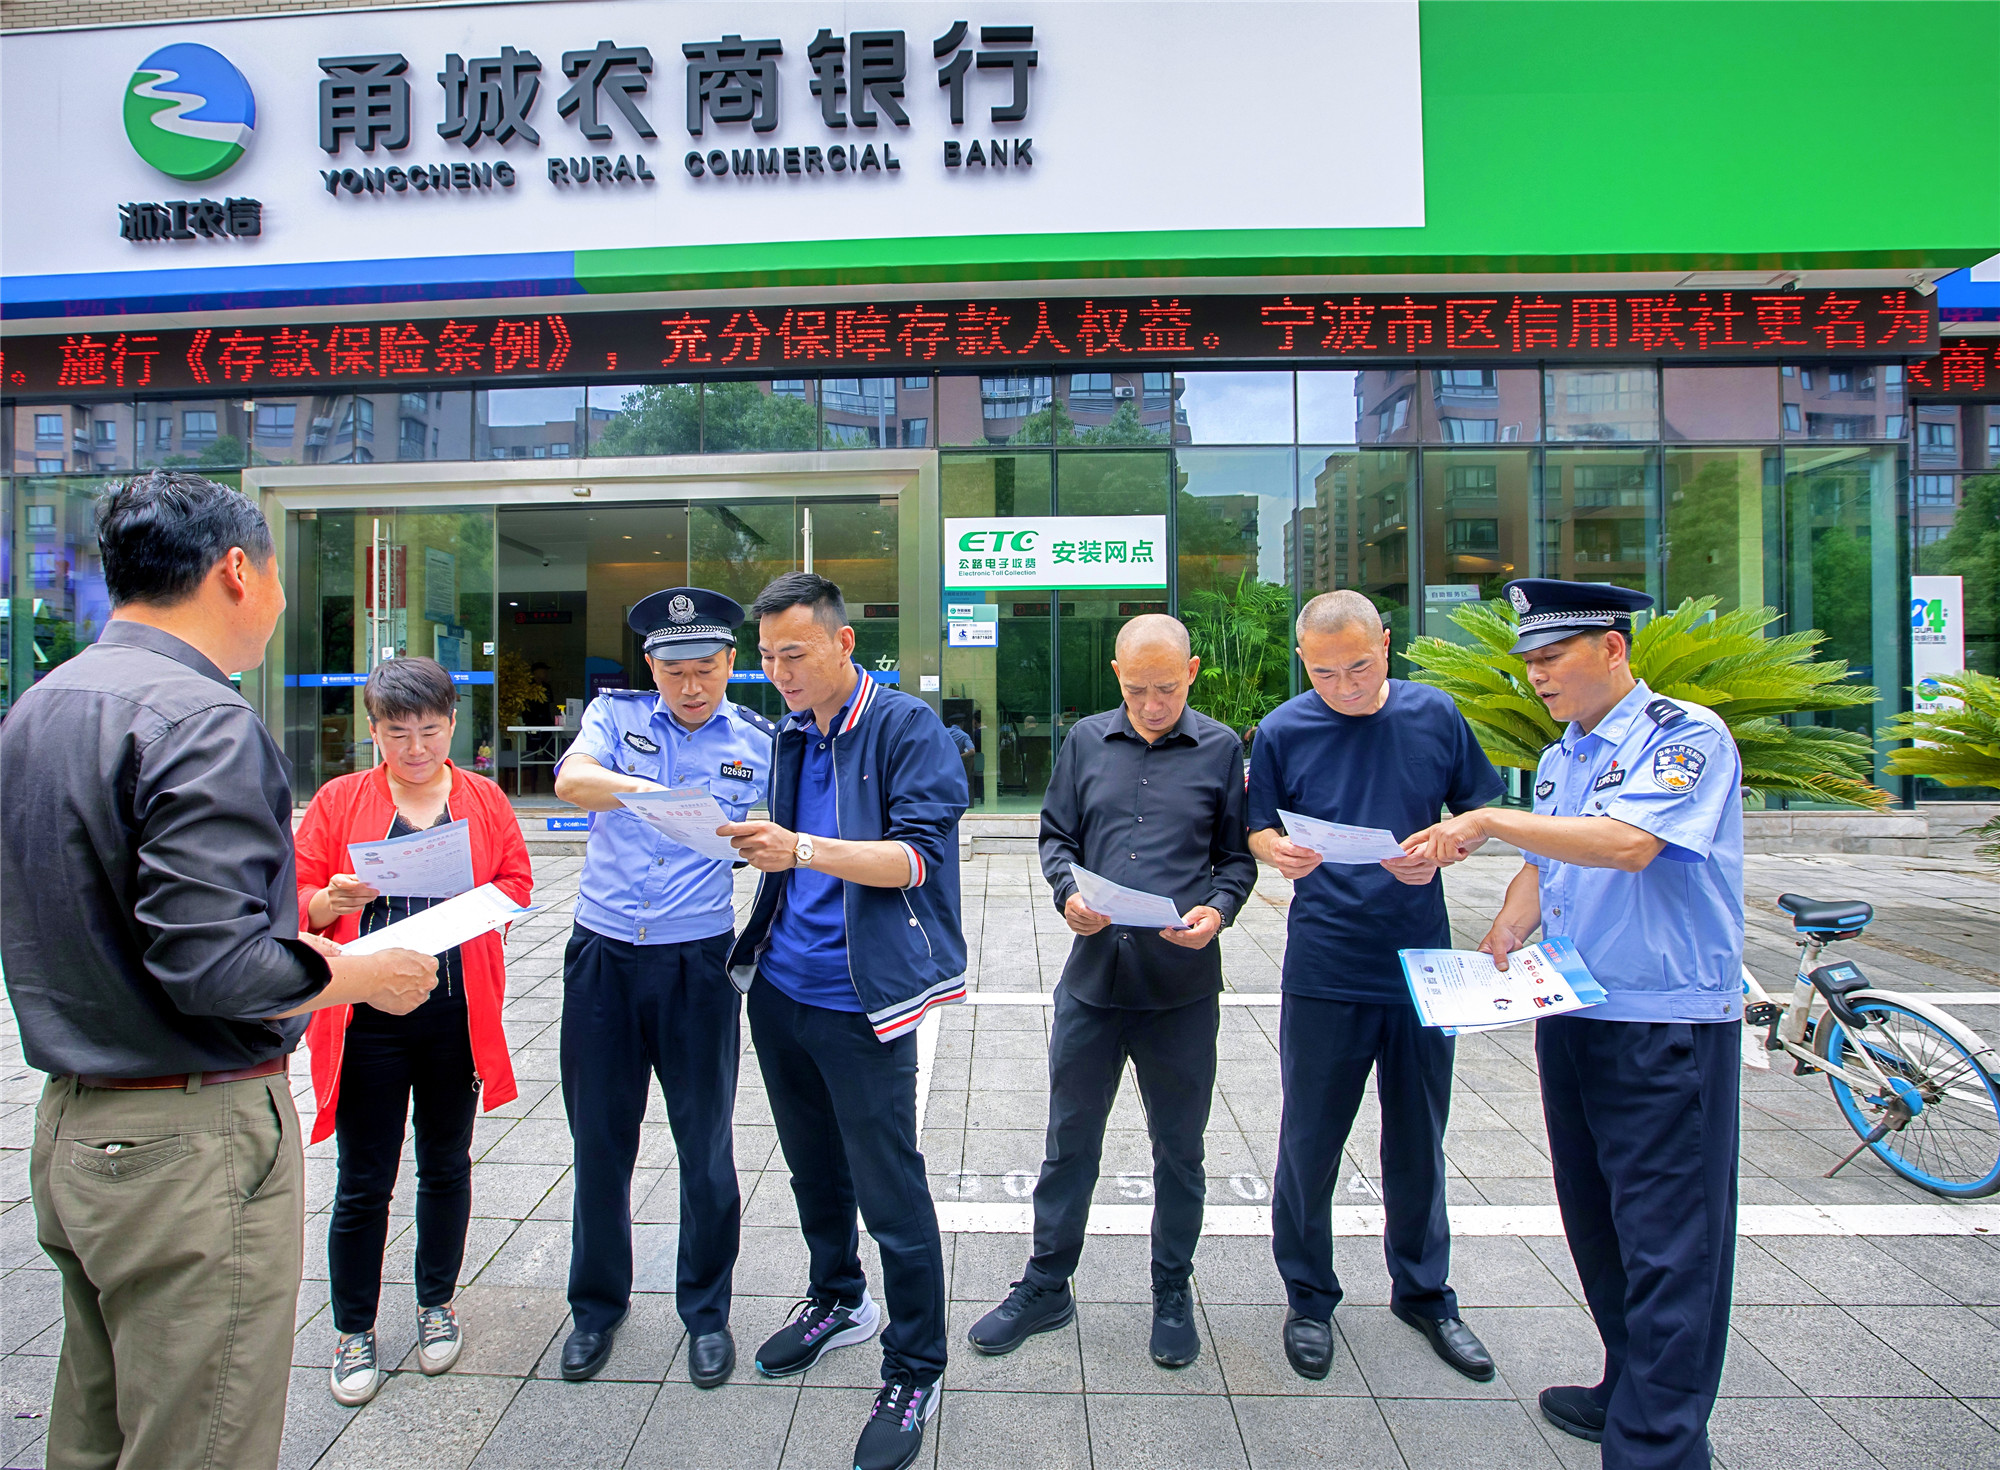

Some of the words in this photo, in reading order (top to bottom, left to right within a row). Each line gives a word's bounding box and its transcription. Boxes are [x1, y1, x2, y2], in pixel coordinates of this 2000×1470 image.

[318, 20, 1039, 153] 甬城农商银行
[319, 158, 516, 197] YONGCHENG
[548, 153, 655, 185] RURAL
[684, 143, 901, 178] COMMERCIAL
[943, 137, 1033, 168] BANK
[118, 197, 263, 241] 浙江农信
[958, 530, 1039, 553] ETC
[1051, 539, 1155, 565] 安装网点
[958, 557, 1036, 569] 公路电子收费
[722, 766, 752, 779] 026937
